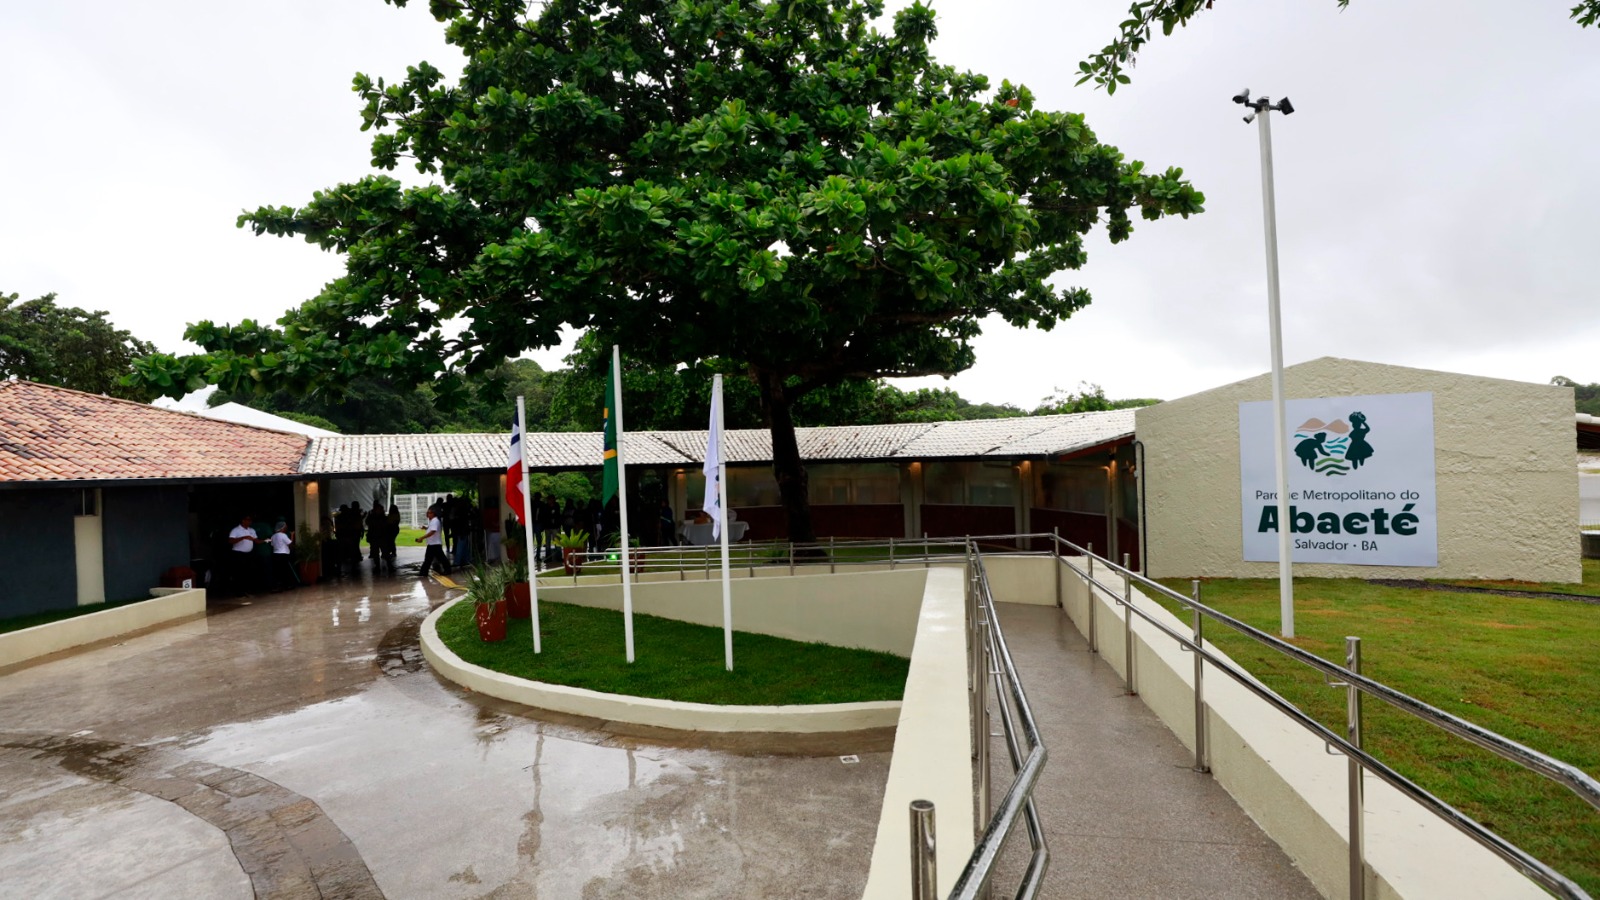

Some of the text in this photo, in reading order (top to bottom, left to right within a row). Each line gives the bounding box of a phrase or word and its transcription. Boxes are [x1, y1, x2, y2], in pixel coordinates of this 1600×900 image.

[1255, 489, 1420, 503] Pare Metropolitano do
[1257, 503, 1420, 536] Abaeté
[1294, 538, 1378, 552] Salvador BA
